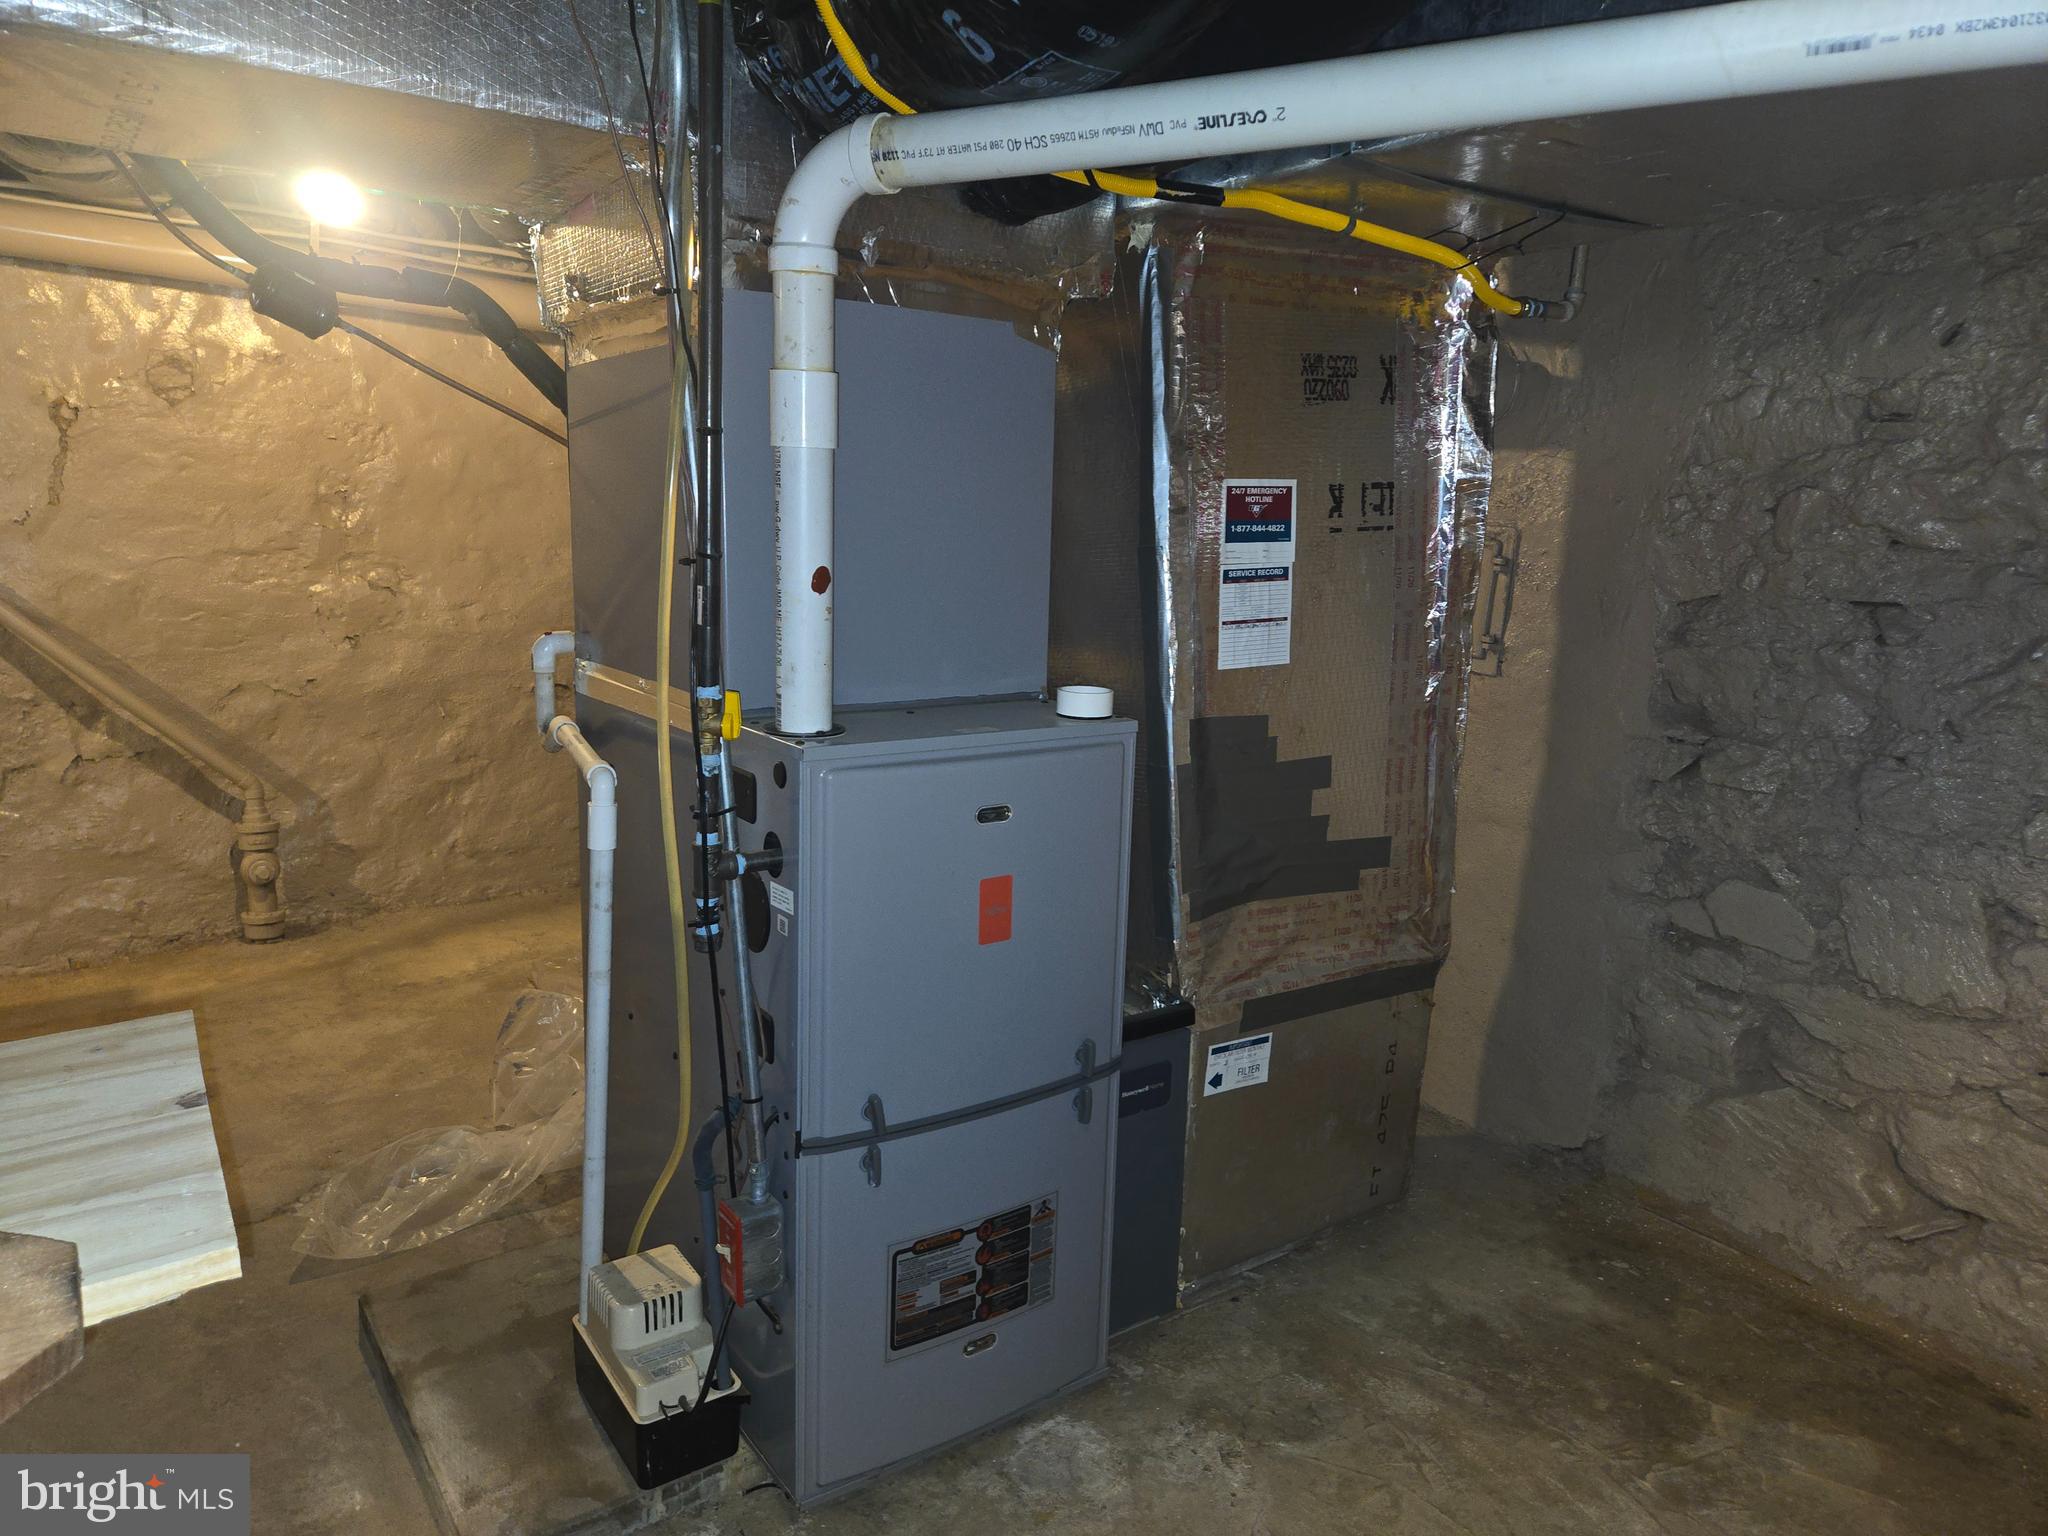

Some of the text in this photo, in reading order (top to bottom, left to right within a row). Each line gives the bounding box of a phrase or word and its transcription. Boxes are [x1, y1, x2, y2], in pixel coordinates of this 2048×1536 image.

[1137, 121, 1165, 138] DWV
[1168, 118, 1188, 130] PVC
[1049, 131, 1076, 144] D2665
[1078, 129, 1100, 141] ASTM
[947, 142, 972, 155] WATER
[973, 141, 988, 152] PSI
[1006, 137, 1023, 152] 40
[1024, 134, 1048, 151] SCH
[900, 148, 916, 159] PVC
[935, 145, 946, 156] AT
[1258, 568, 1284, 576] RECORD
[1237, 1064, 1260, 1077] FILTER
